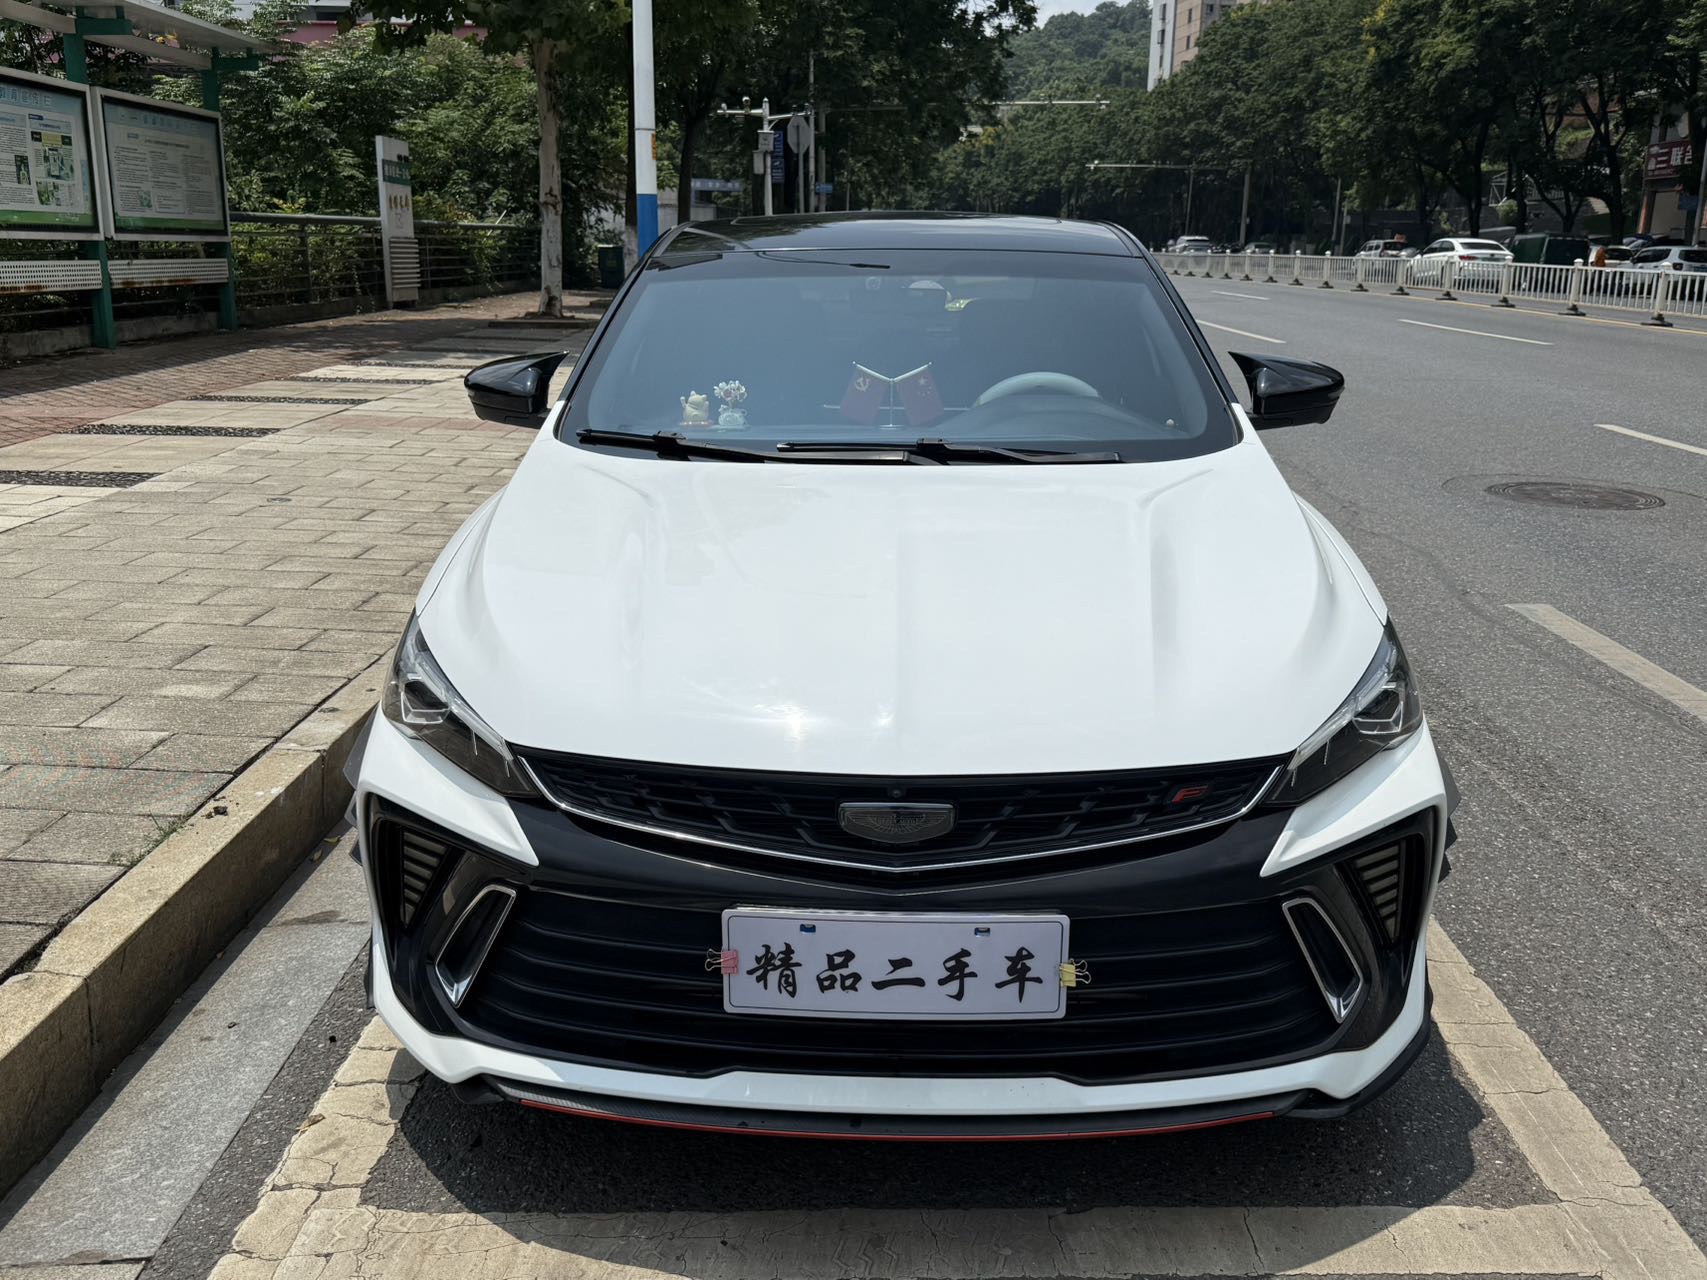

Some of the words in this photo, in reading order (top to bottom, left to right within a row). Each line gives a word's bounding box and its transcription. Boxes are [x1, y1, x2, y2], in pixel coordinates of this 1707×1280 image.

[746, 942, 1043, 1003] 精品二手车
